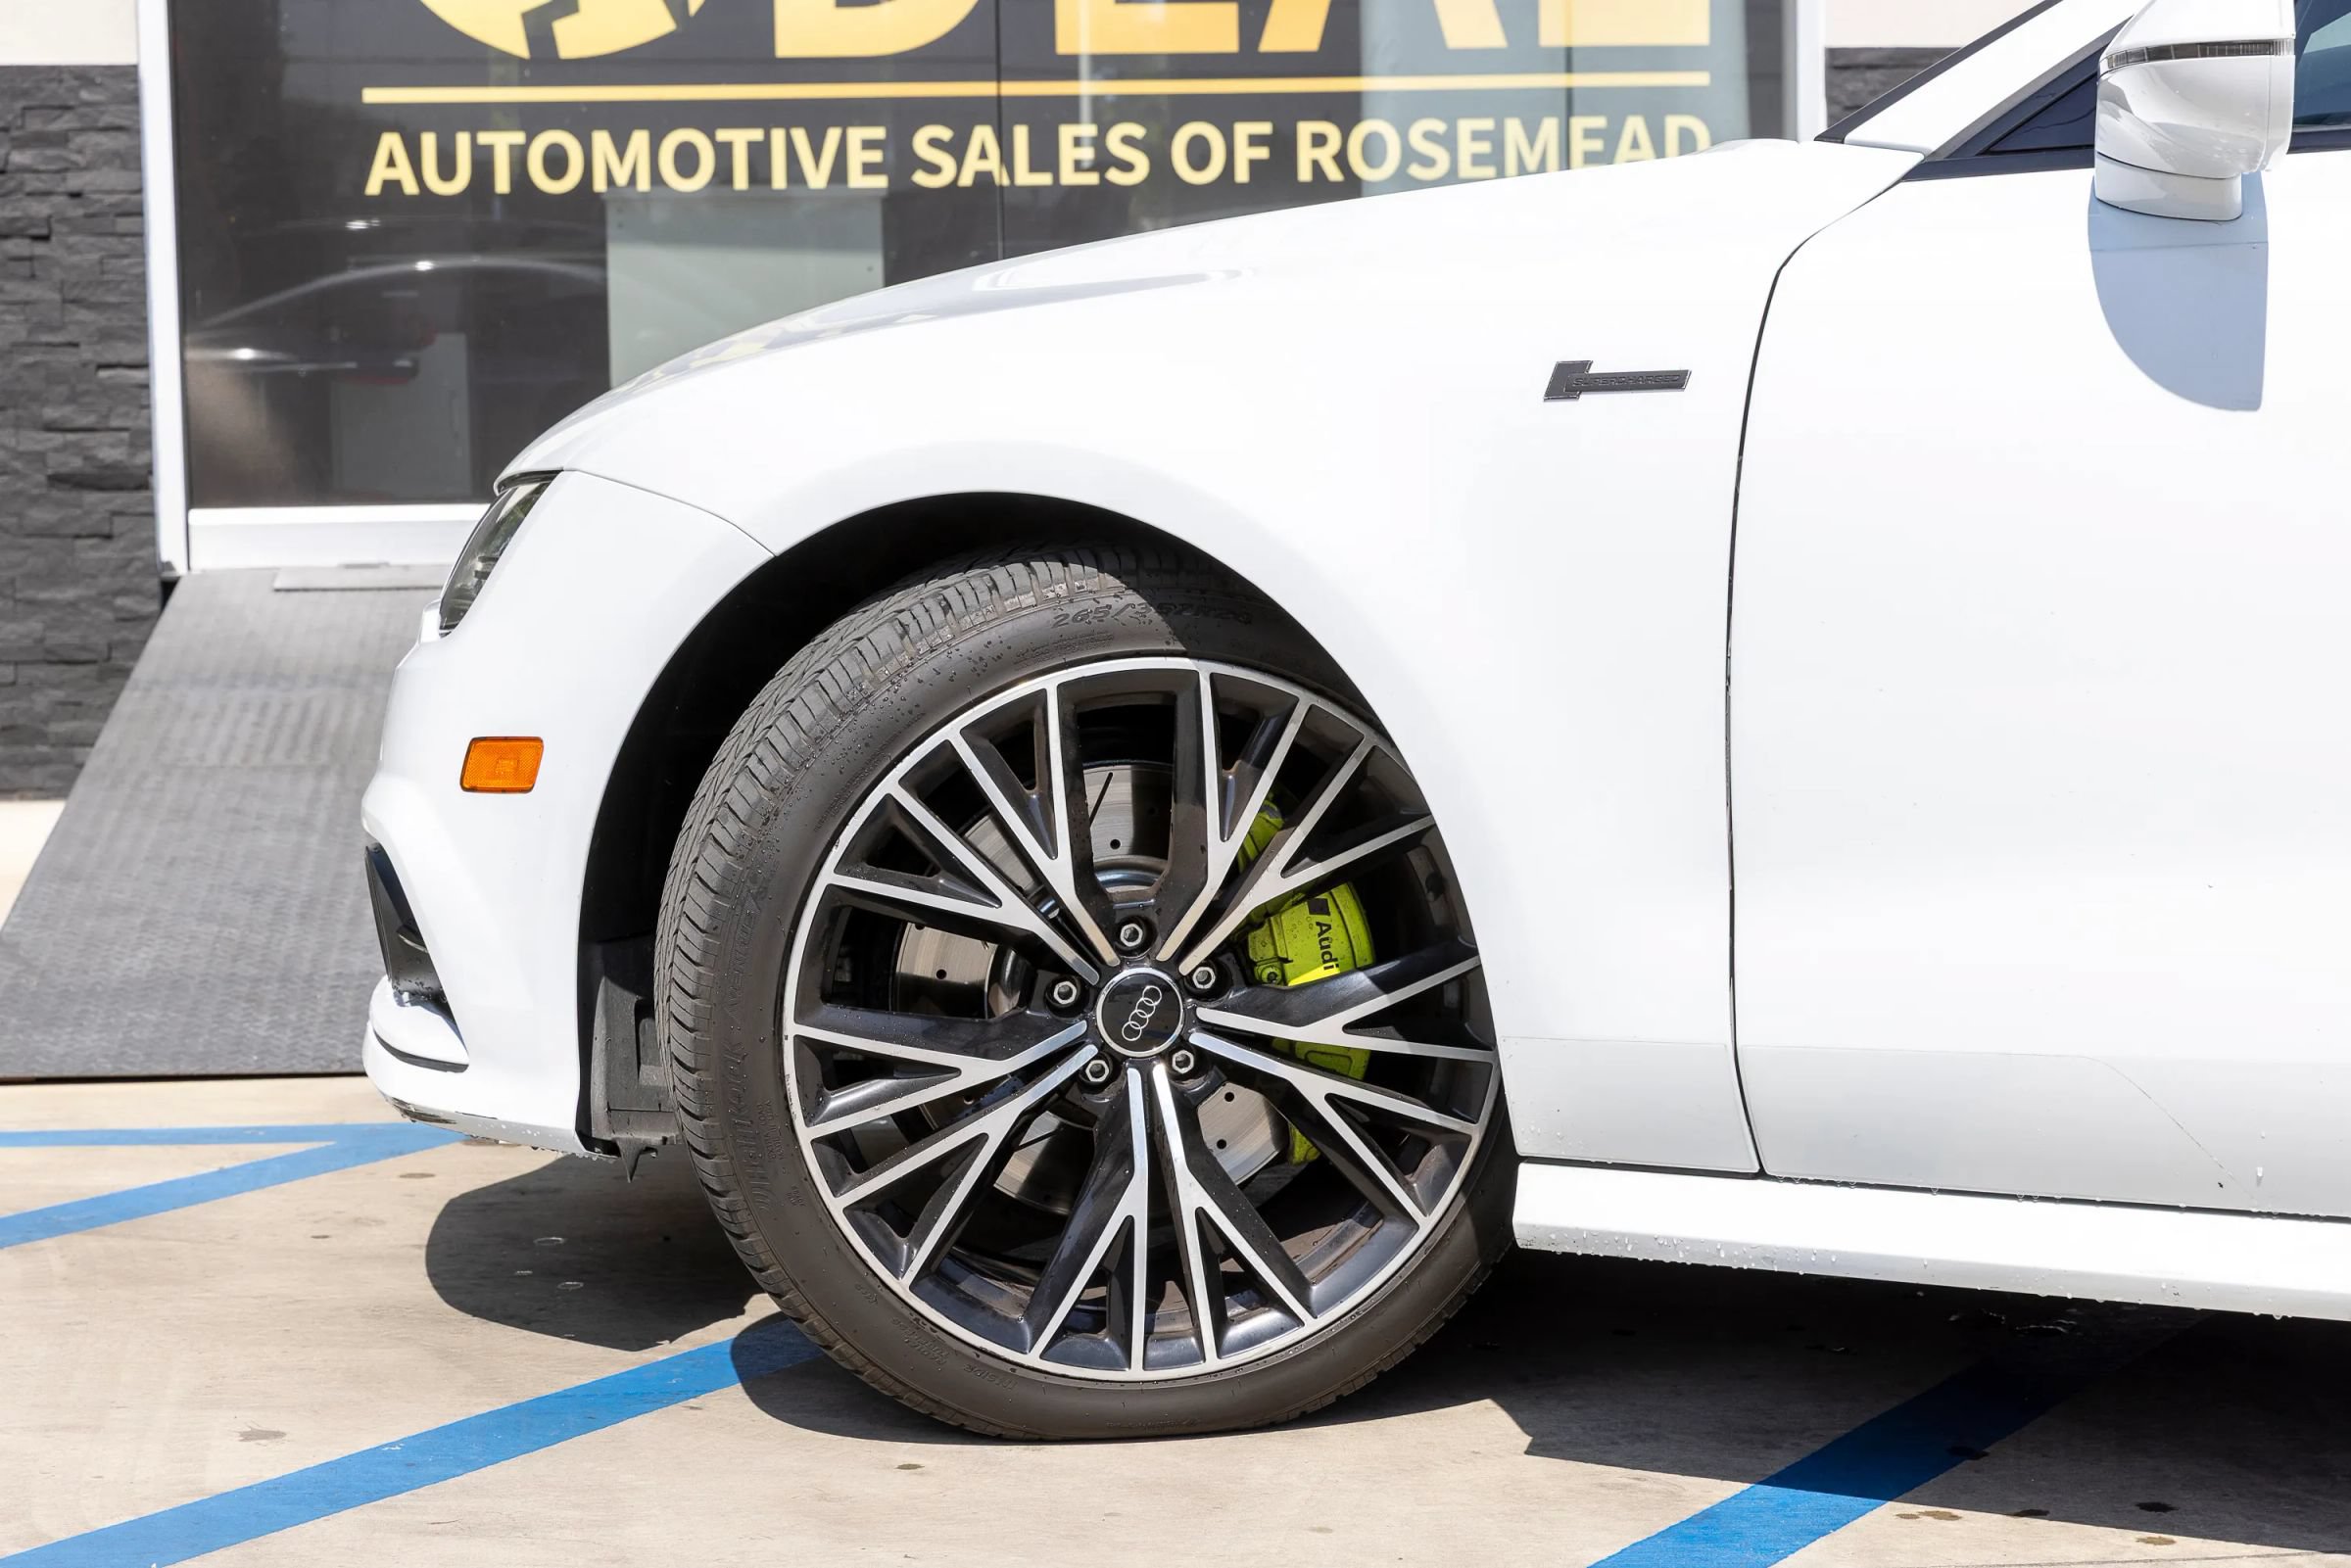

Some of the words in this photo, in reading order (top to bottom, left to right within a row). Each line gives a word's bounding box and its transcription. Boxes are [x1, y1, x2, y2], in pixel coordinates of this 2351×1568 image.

[363, 125, 888, 196] AUTOMOTIVE
[911, 121, 1151, 189] SALES
[1170, 119, 1274, 186] OF
[1296, 114, 1711, 183] ROSEMEAD
[1315, 921, 1341, 973] Audi
